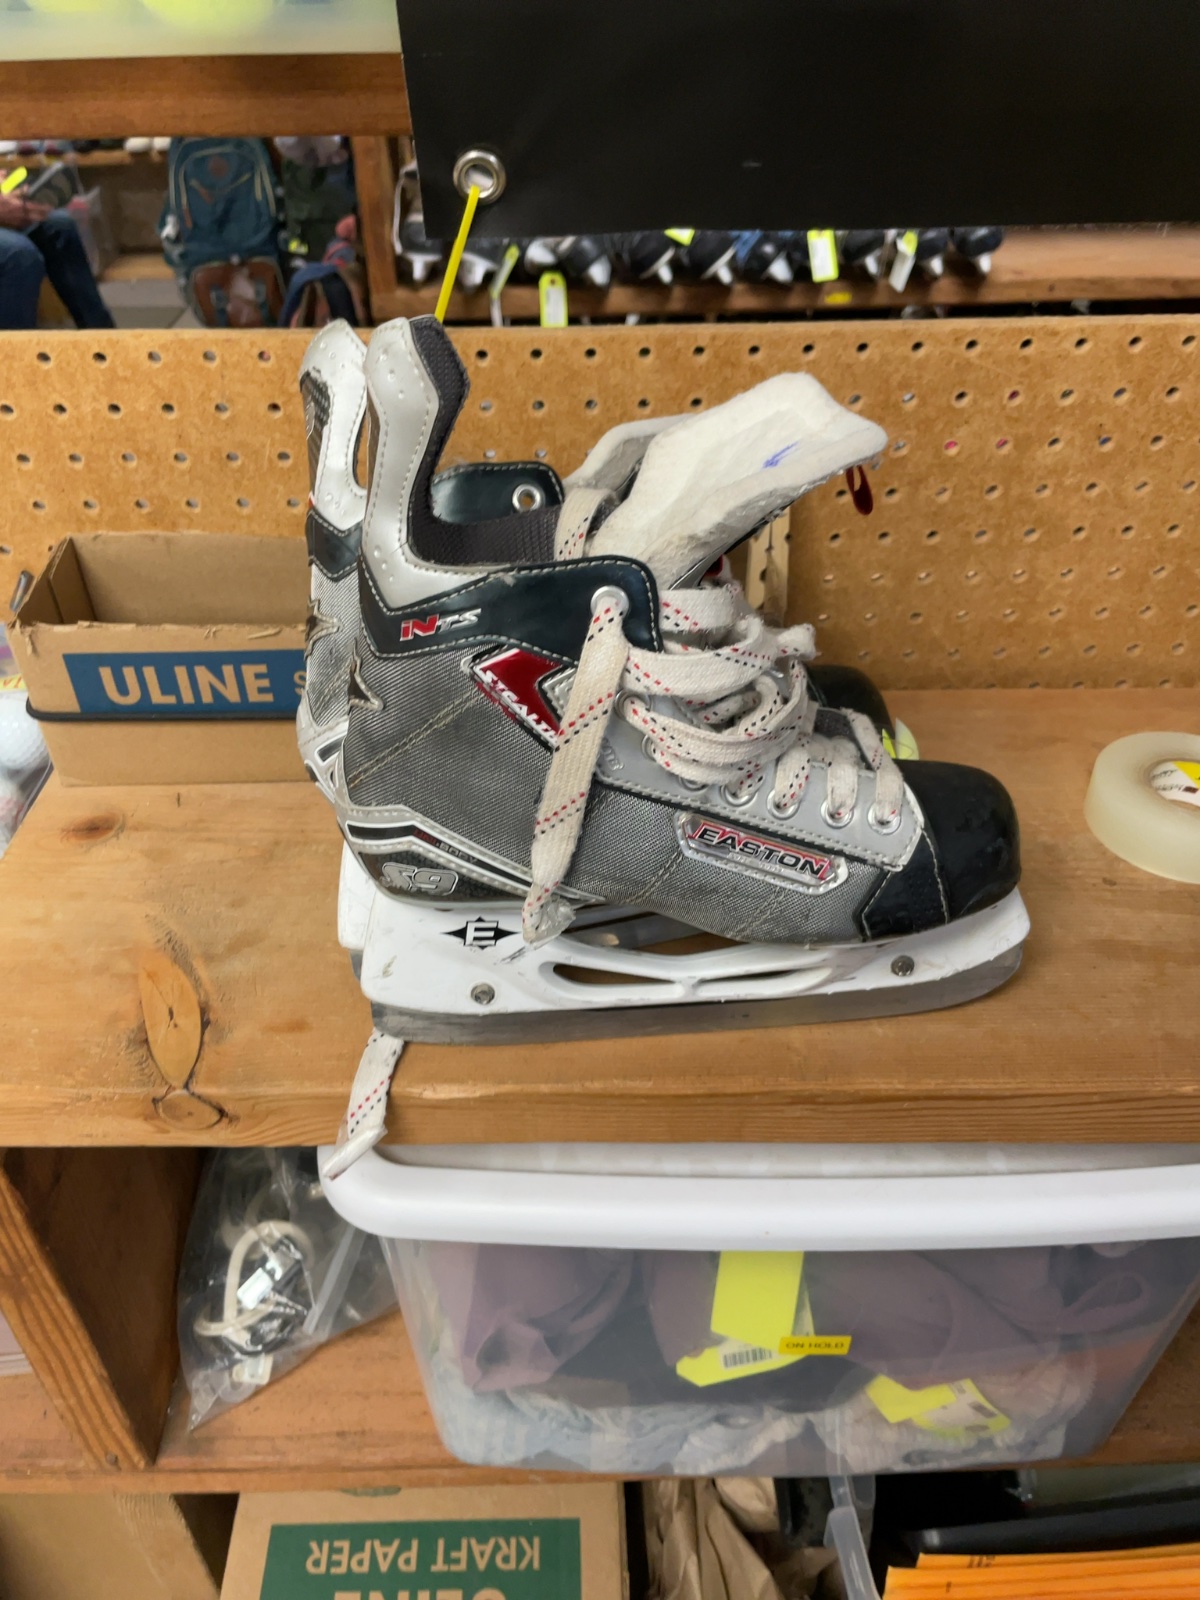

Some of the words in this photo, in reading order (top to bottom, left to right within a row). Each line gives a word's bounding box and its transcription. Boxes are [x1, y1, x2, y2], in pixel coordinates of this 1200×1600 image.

[98, 664, 274, 705] ULINE
[694, 825, 828, 879] EASTON
[786, 1341, 805, 1349] ON
[808, 1341, 844, 1349] HOLD
[305, 1537, 419, 1575] PAPER
[430, 1536, 540, 1572] KRAFT
